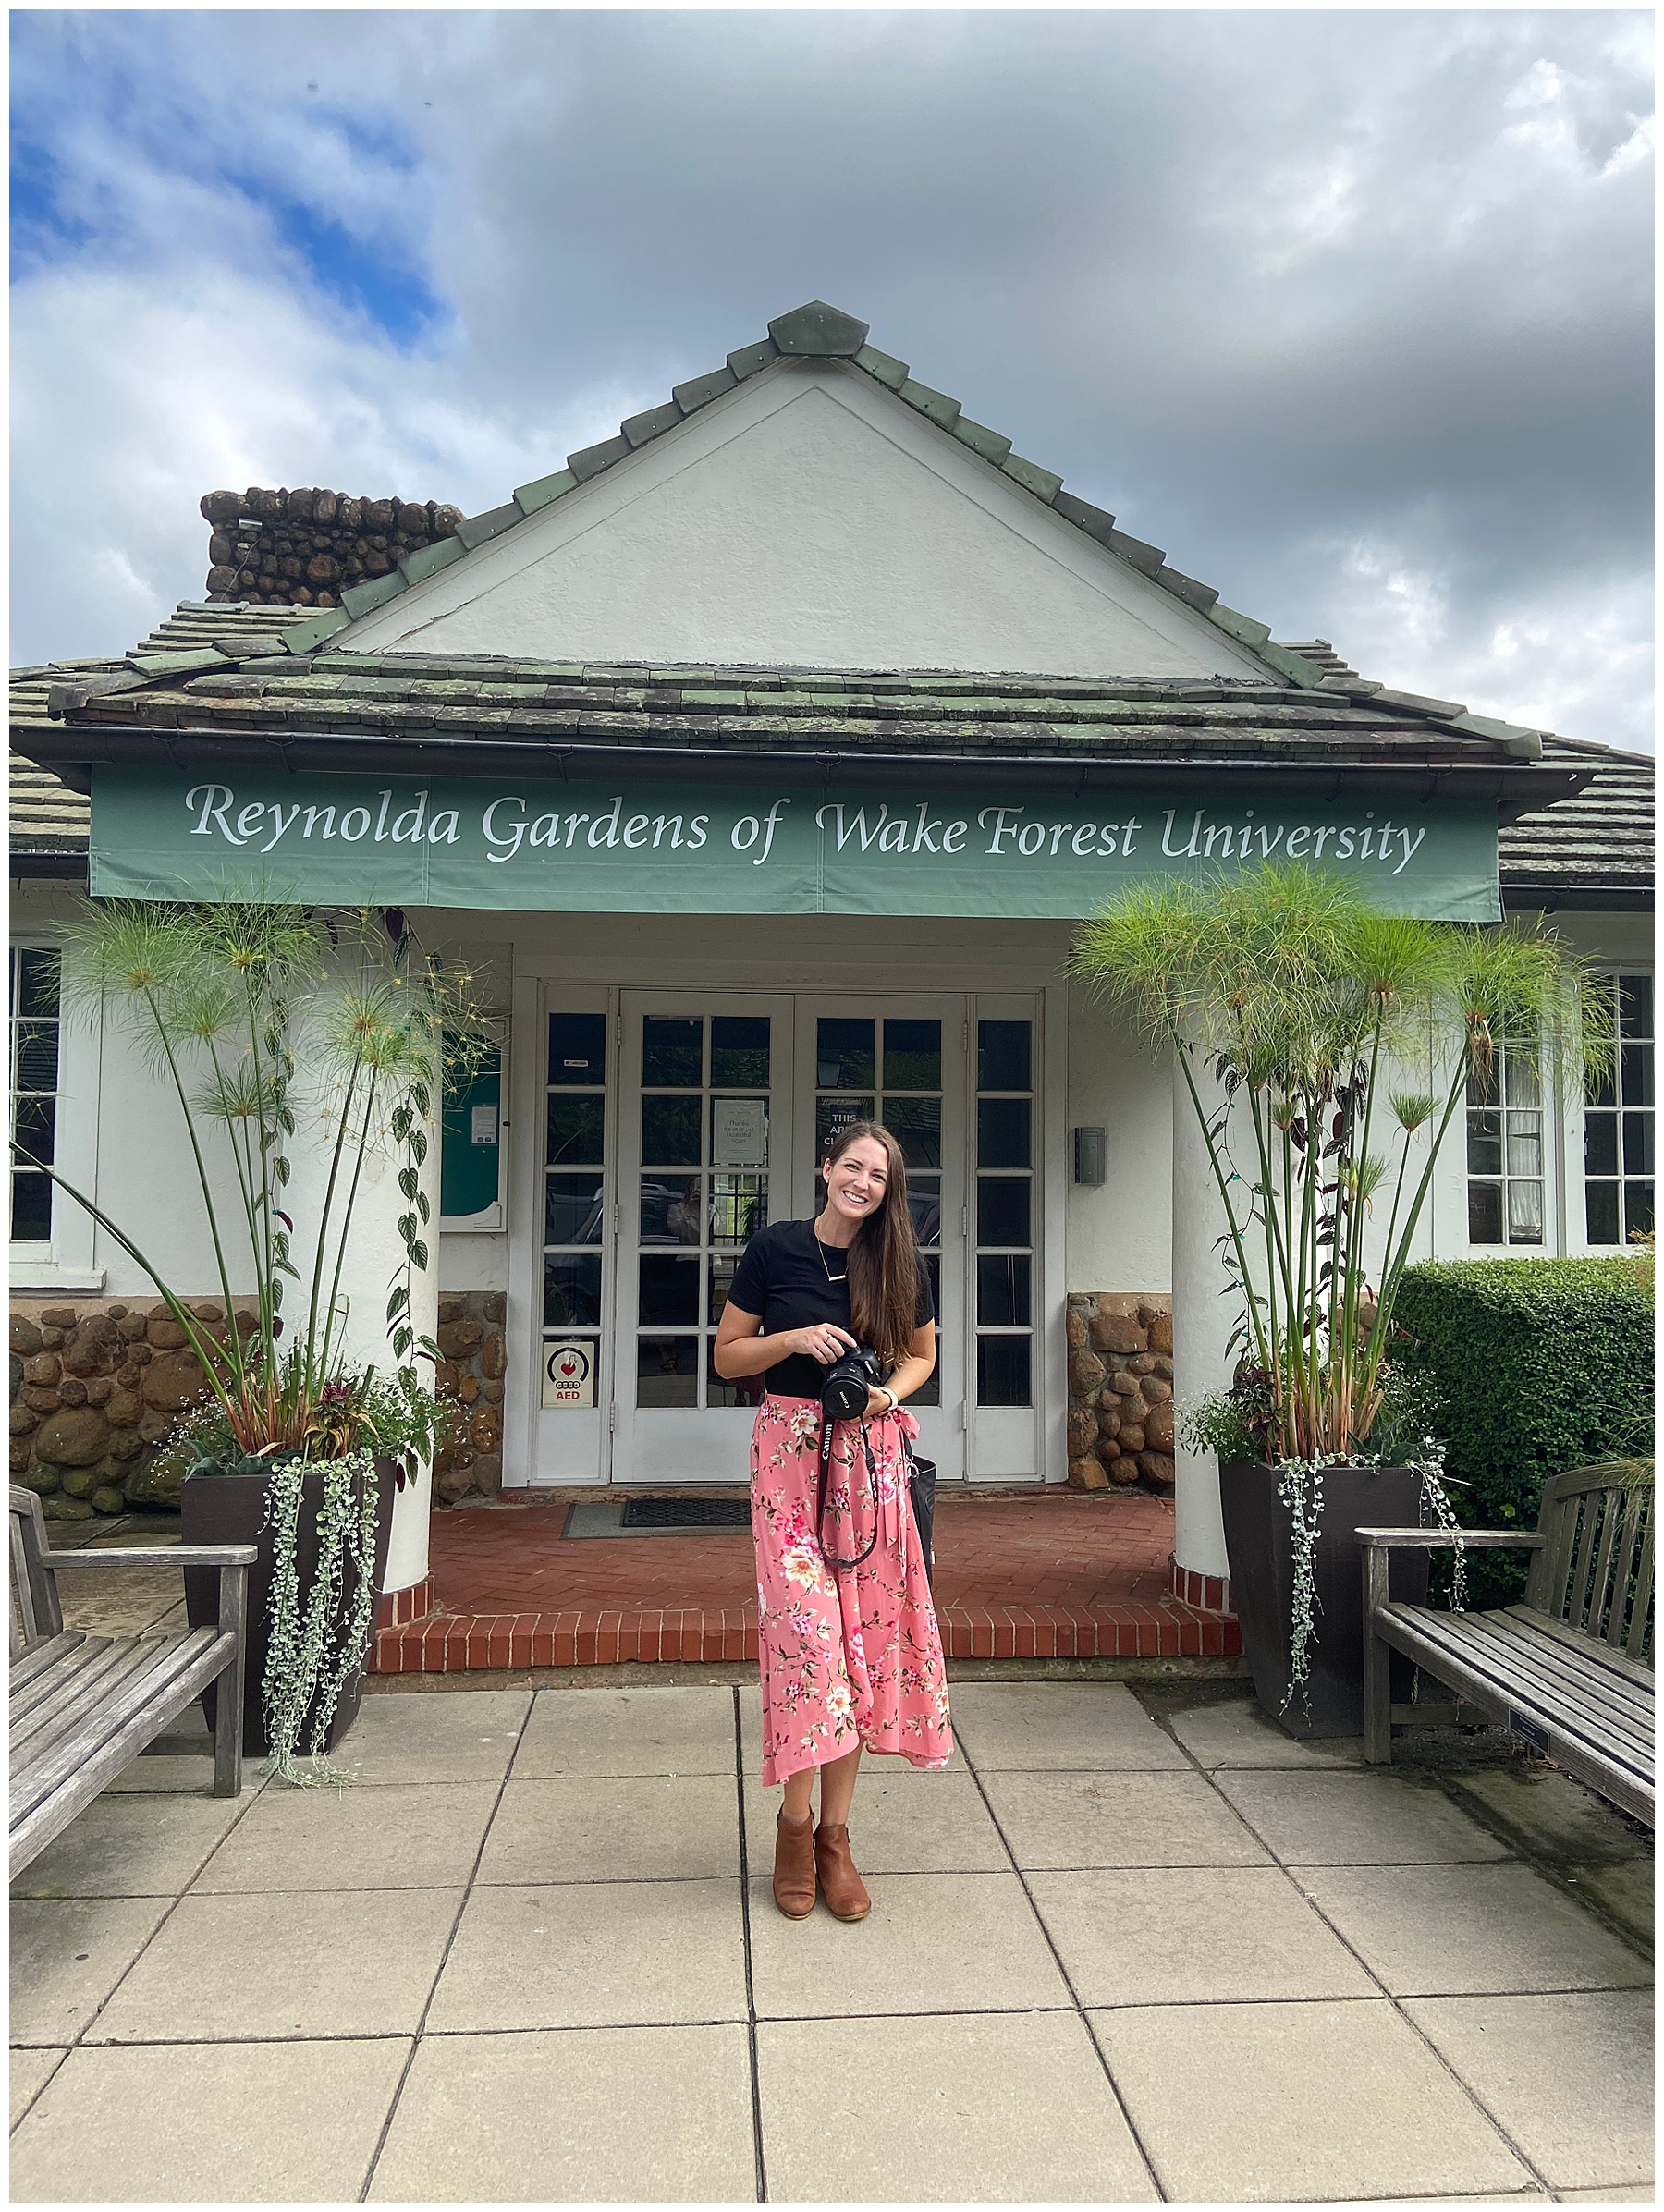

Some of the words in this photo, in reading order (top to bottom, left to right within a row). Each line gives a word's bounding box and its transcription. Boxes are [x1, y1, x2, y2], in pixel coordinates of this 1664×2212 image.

[185, 783, 460, 854] Reynolda
[481, 795, 709, 863] Gardens
[729, 797, 792, 866] of
[815, 800, 968, 854] Wake
[976, 805, 1143, 858] Forest
[1160, 807, 1426, 875] University
[832, 1114, 857, 1122] THIS
[556, 1391, 580, 1400] AED
[822, 1424, 833, 1460] Canon
